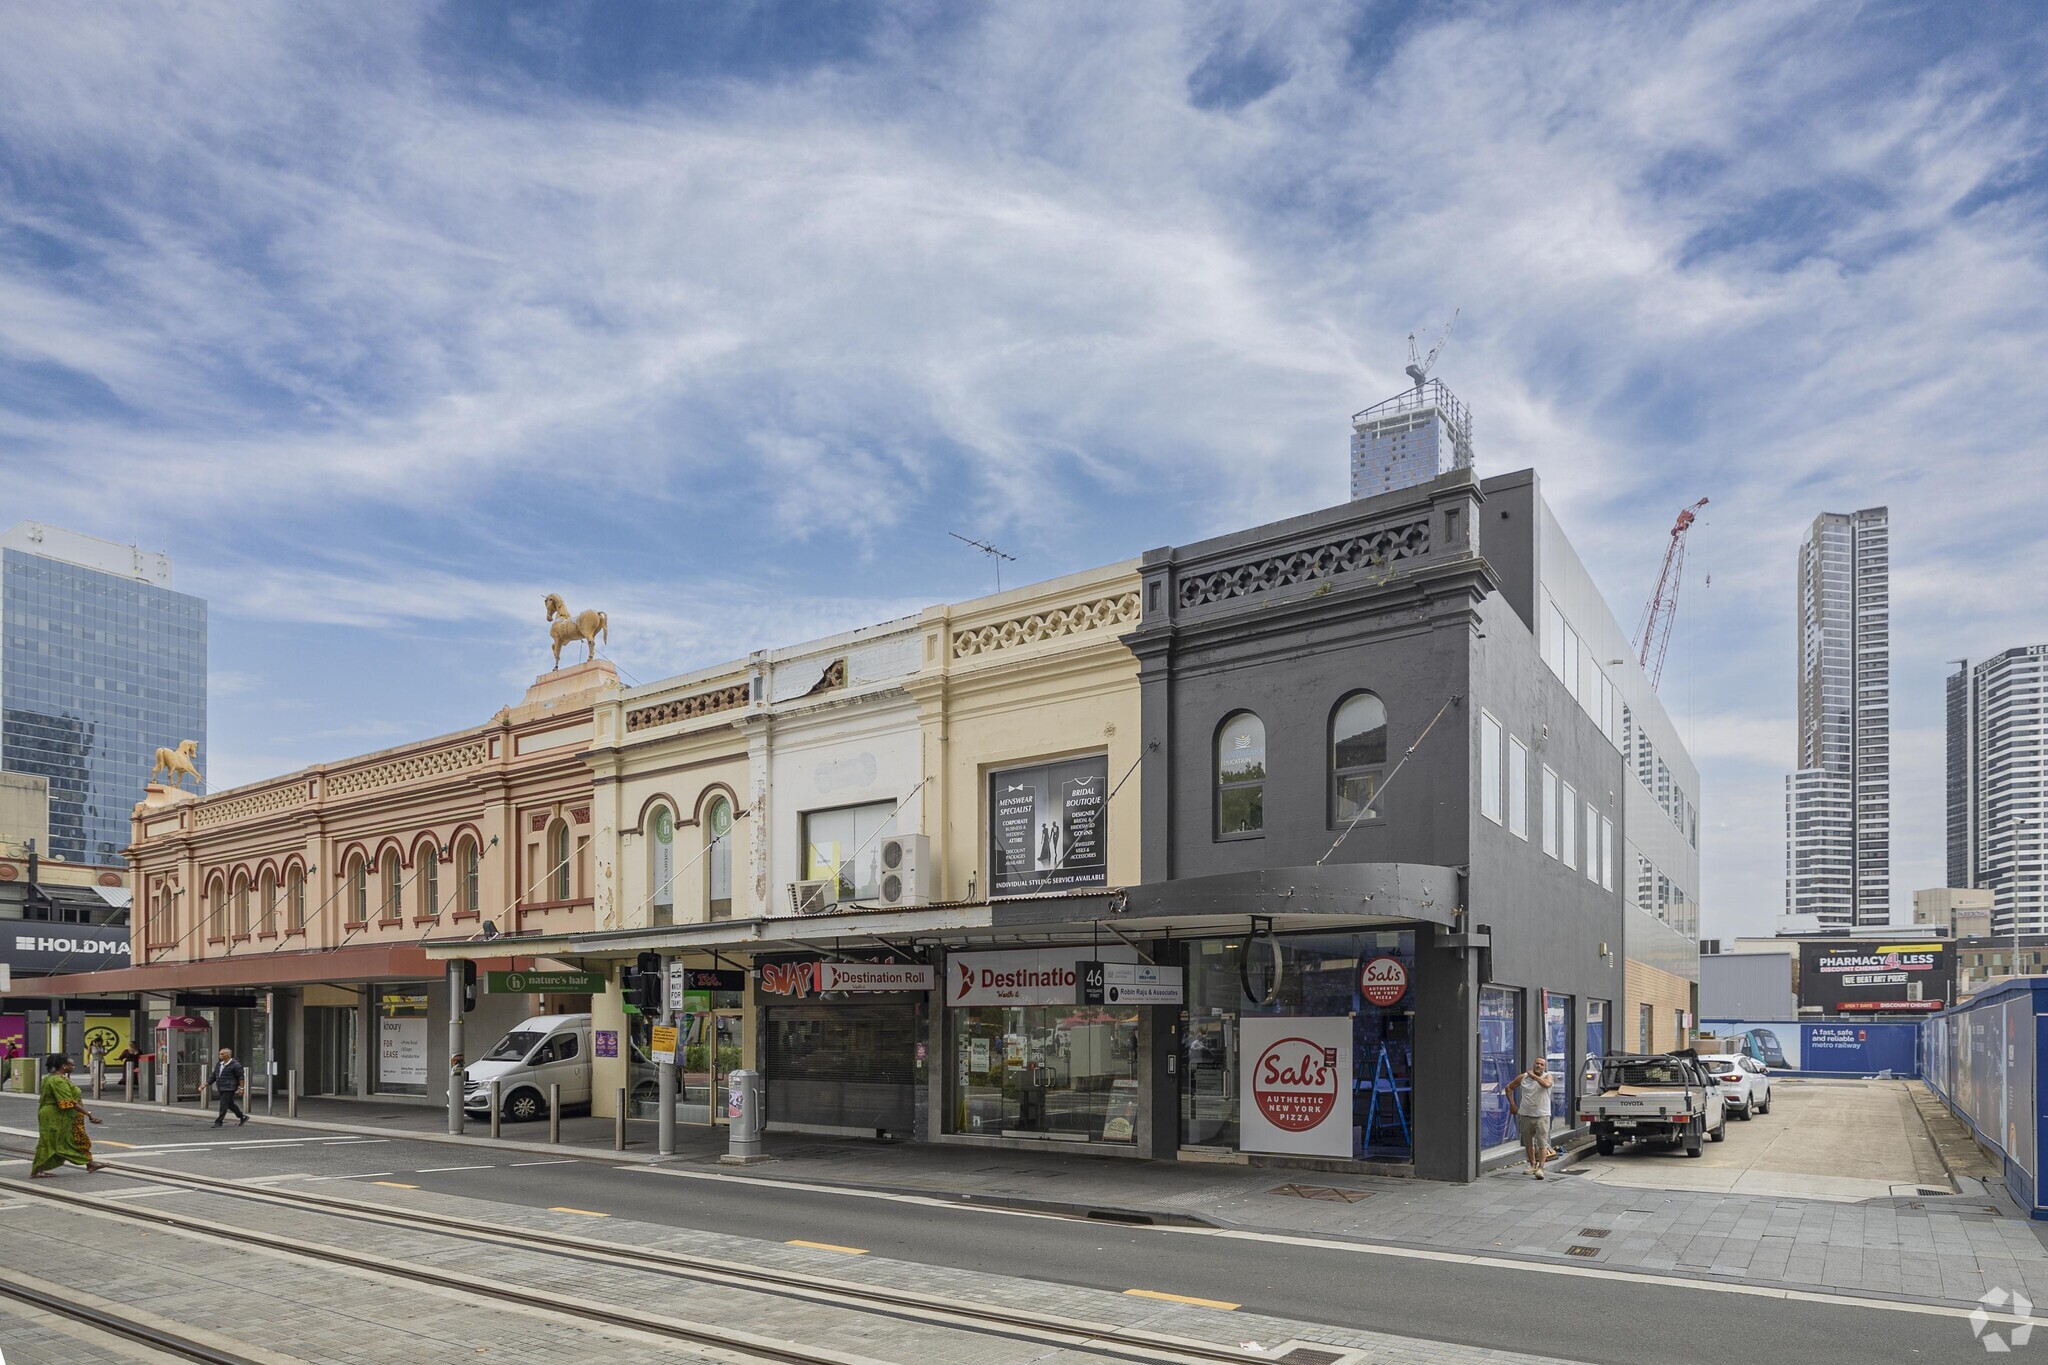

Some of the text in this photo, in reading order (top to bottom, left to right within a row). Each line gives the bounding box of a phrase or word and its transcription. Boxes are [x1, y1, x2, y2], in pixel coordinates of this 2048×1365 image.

[1072, 787, 1095, 797] BRIDAL
[999, 796, 1033, 806] MENSWEAR
[1066, 796, 1101, 807] BOUTIQUE
[1000, 805, 1032, 816] SPECIALIST
[995, 873, 1105, 888] INDIVIDUAL STYLING SERVICE AVAILABLE
[37, 937, 131, 955] HOLDMA
[1819, 952, 1934, 969] PHARMACY 4 LESS
[1367, 965, 1401, 982] Sal's
[1820, 965, 1854, 973] DISCOUNT
[528, 976, 589, 985] nature's hair
[842, 971, 925, 984] Destination Roll
[981, 967, 1077, 988] Destinatio
[1086, 969, 1103, 986] 46
[1887, 974, 1907, 983] PRICE
[1136, 988, 1147, 996] Raju
[383, 1021, 402, 1033] khoury
[383, 1040, 394, 1048] FOR
[383, 1050, 399, 1059] LEASE
[1264, 1053, 1328, 1086] Sal's
[1266, 1095, 1324, 1104] AUTHENTIC
[1269, 1104, 1321, 1113] NEW YORK
[1279, 1113, 1310, 1122] PIZZA
